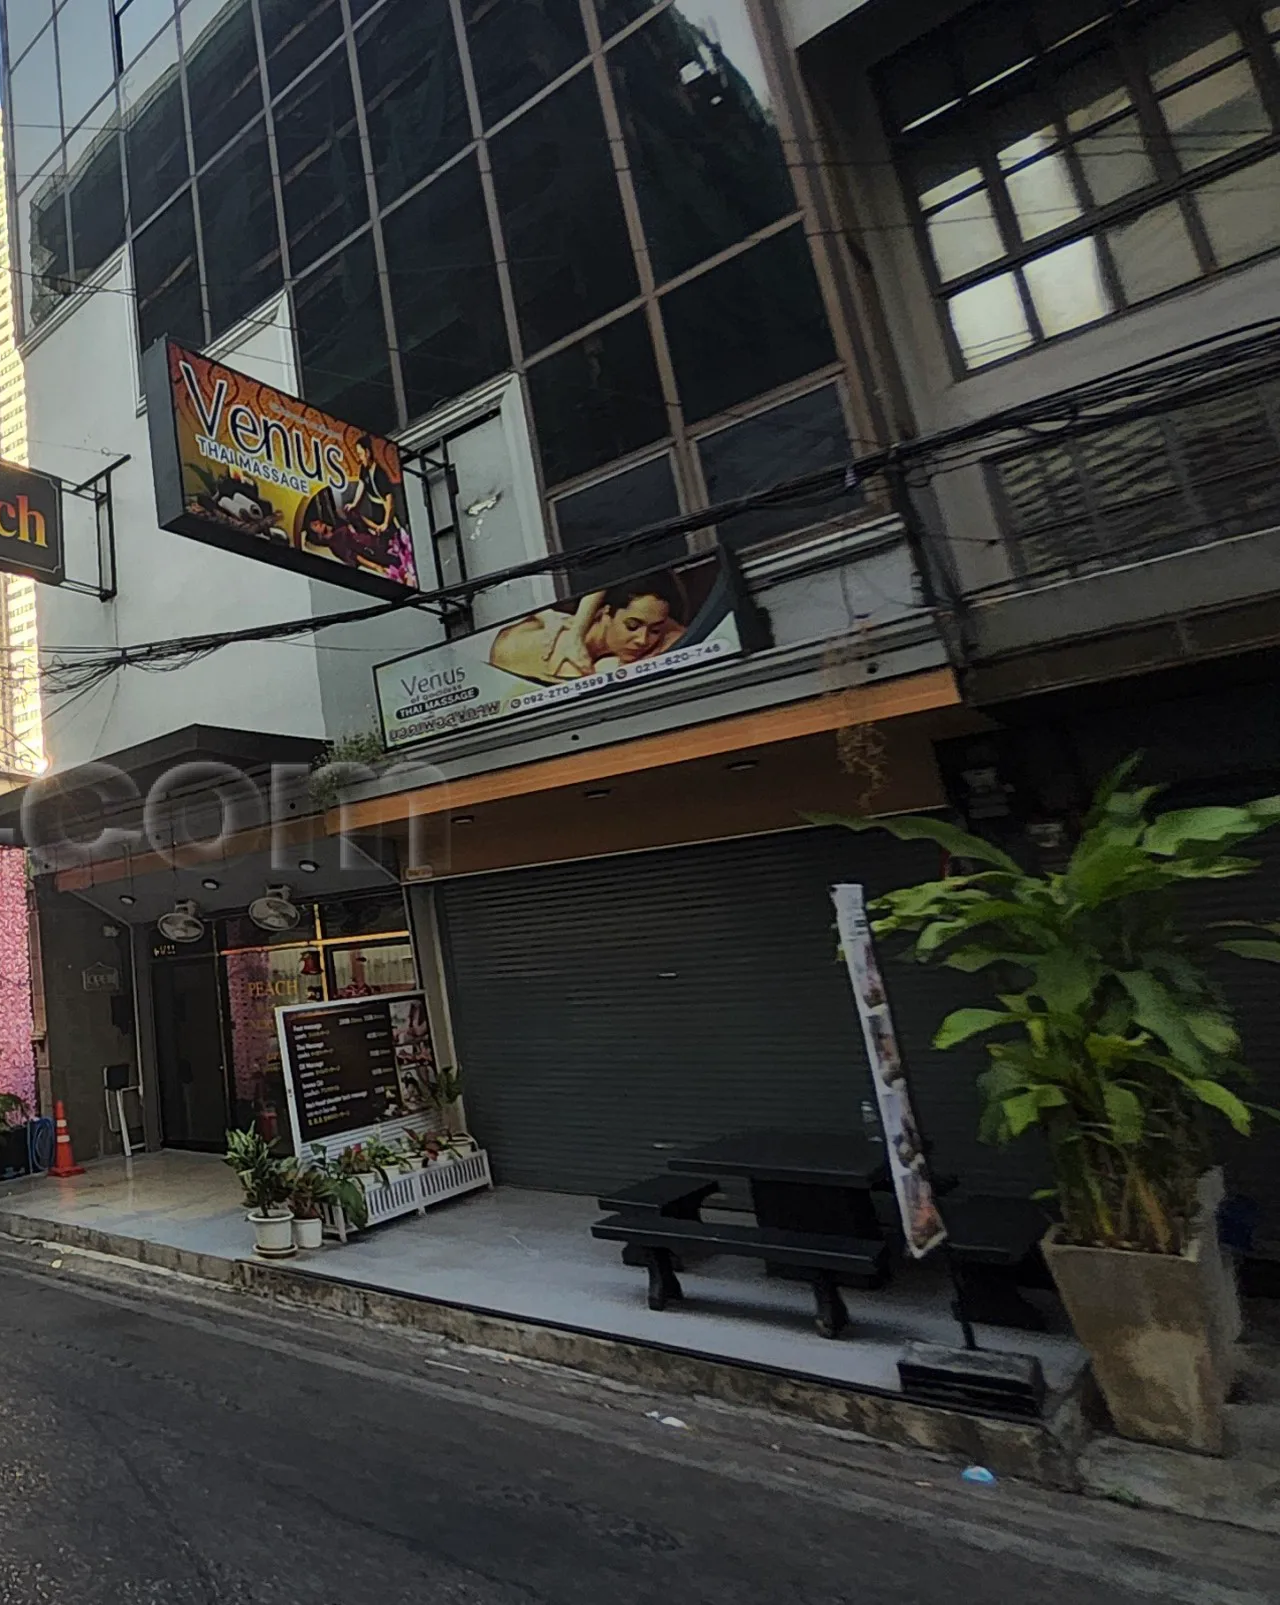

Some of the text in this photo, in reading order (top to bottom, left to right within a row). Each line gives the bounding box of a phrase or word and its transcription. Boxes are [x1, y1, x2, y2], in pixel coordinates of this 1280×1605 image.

[180, 361, 348, 491] Venus
[197, 436, 310, 494] THAI MASSAGE
[400, 666, 466, 696] Venus
[399, 688, 475, 718] THAI MASSAGE
[248, 980, 298, 996] PEACH
